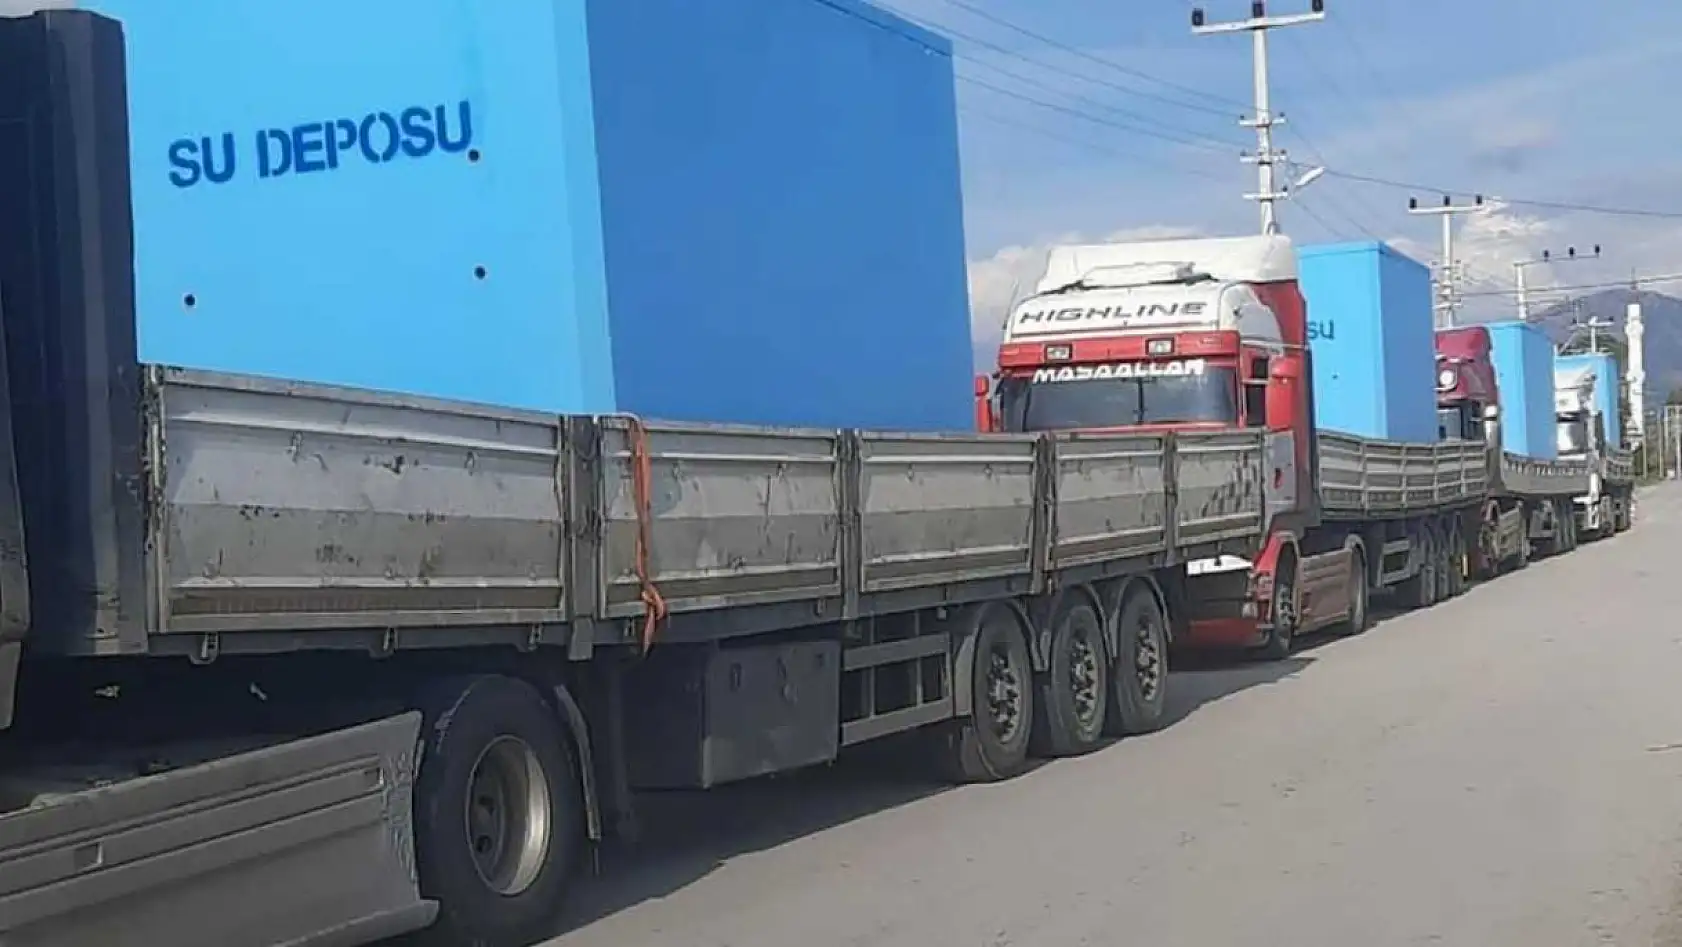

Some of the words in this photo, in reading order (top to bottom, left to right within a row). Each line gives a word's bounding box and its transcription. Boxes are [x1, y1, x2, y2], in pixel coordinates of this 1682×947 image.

[168, 132, 235, 188] SU
[256, 100, 473, 178] DEPOSU
[1020, 302, 1207, 324] HIGHLINE
